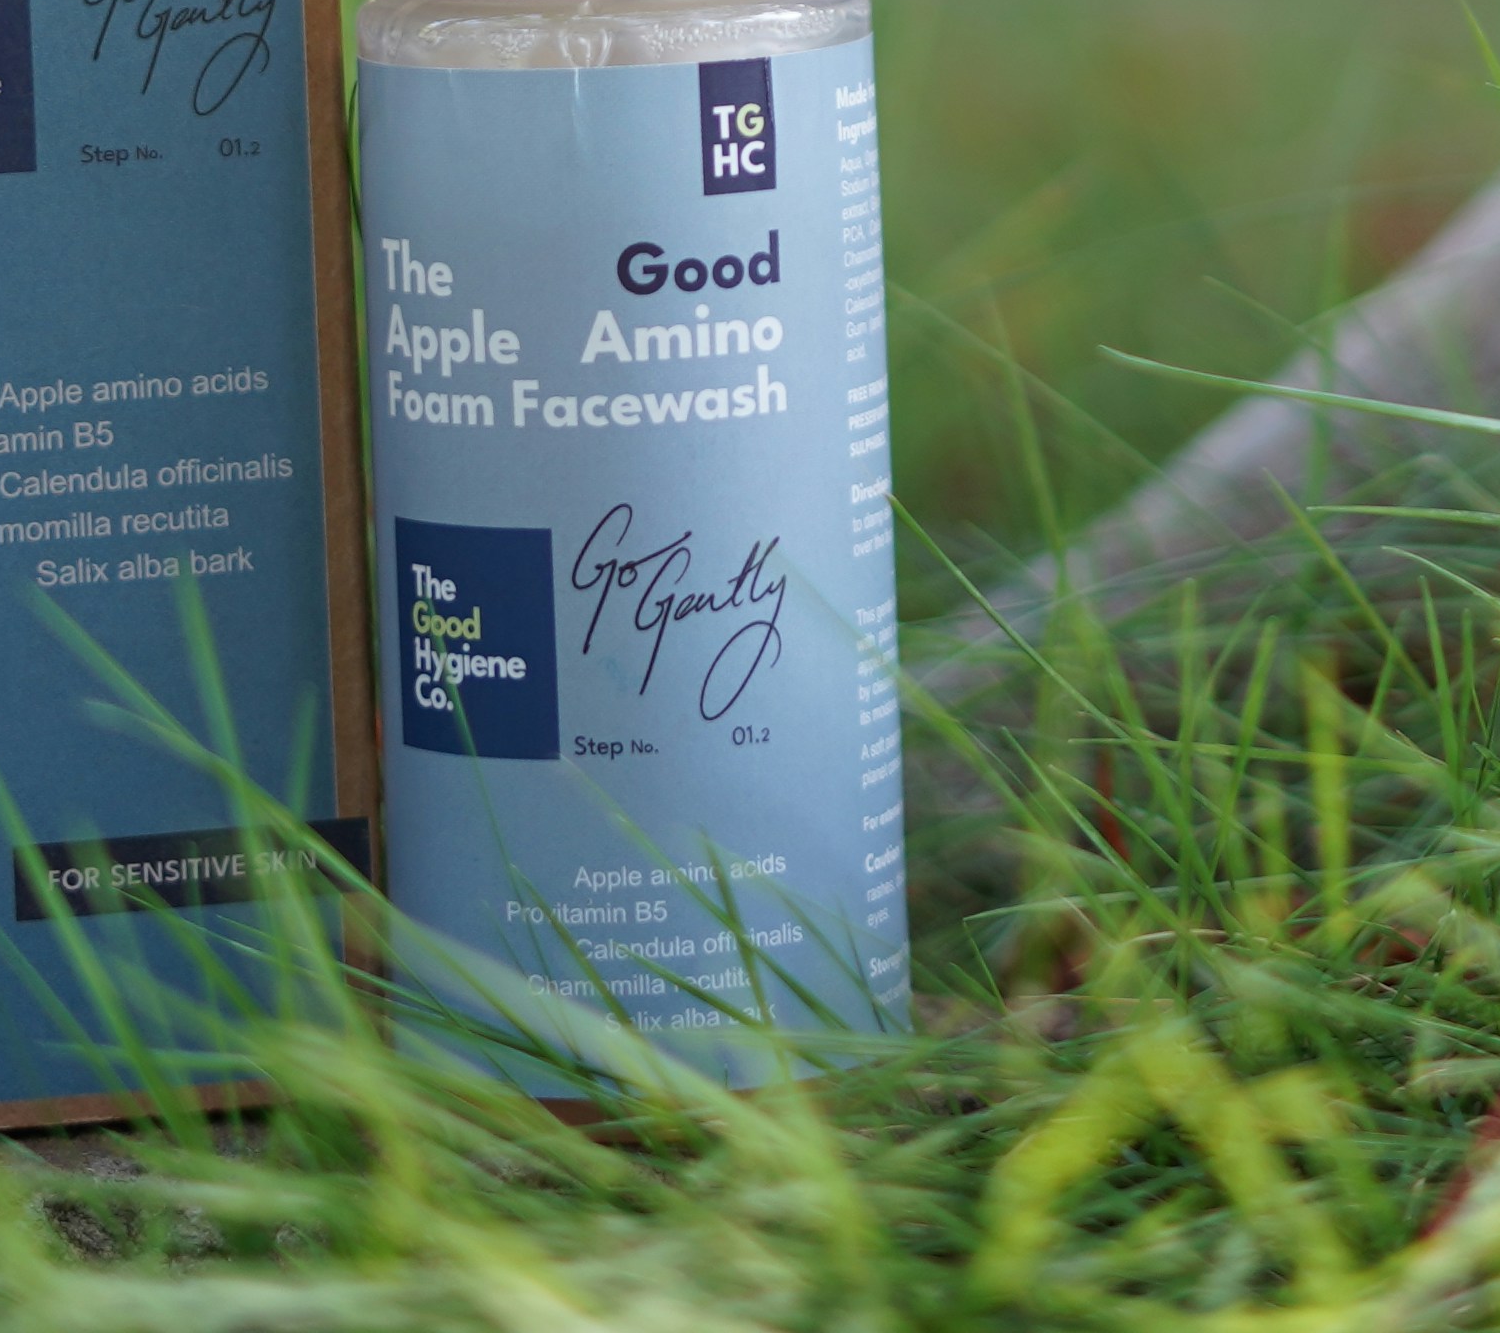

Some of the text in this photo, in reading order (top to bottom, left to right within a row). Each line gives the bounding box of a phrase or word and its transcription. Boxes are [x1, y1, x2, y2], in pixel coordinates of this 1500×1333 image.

[712, 102, 765, 140] TG
[80, 144, 130, 165] Step
[136, 144, 164, 161] No.
[713, 140, 767, 178] HC
[380, 237, 454, 297] The
[616, 229, 781, 296] Good
[385, 303, 784, 379] Apple Amino
[92, 373, 183, 402] amino
[192, 366, 270, 396] acids
[387, 363, 788, 428] Foam Facewash
[73, 421, 115, 448] B5
[0, 453, 294, 499] Calendula officinalis
[121, 504, 230, 534] recutita
[36, 545, 255, 588] Salix alba bark
[412, 563, 457, 603] The
[571, 503, 692, 655] Go
[412, 602, 482, 641] Good
[414, 637, 527, 685] Hygiene
[414, 679, 455, 712] Co.
[574, 736, 625, 761] Step
[631, 738, 660, 756] No.
[48, 848, 318, 892] FOR SENSITIVE SKN
[573, 866, 643, 893] Apple
[730, 852, 788, 880] acids
[635, 899, 668, 923] B5
[703, 922, 804, 955] offiinalis
[527, 973, 667, 998] Chammilla
[605, 1011, 663, 1034] Slix
[671, 1007, 721, 1030] alba
